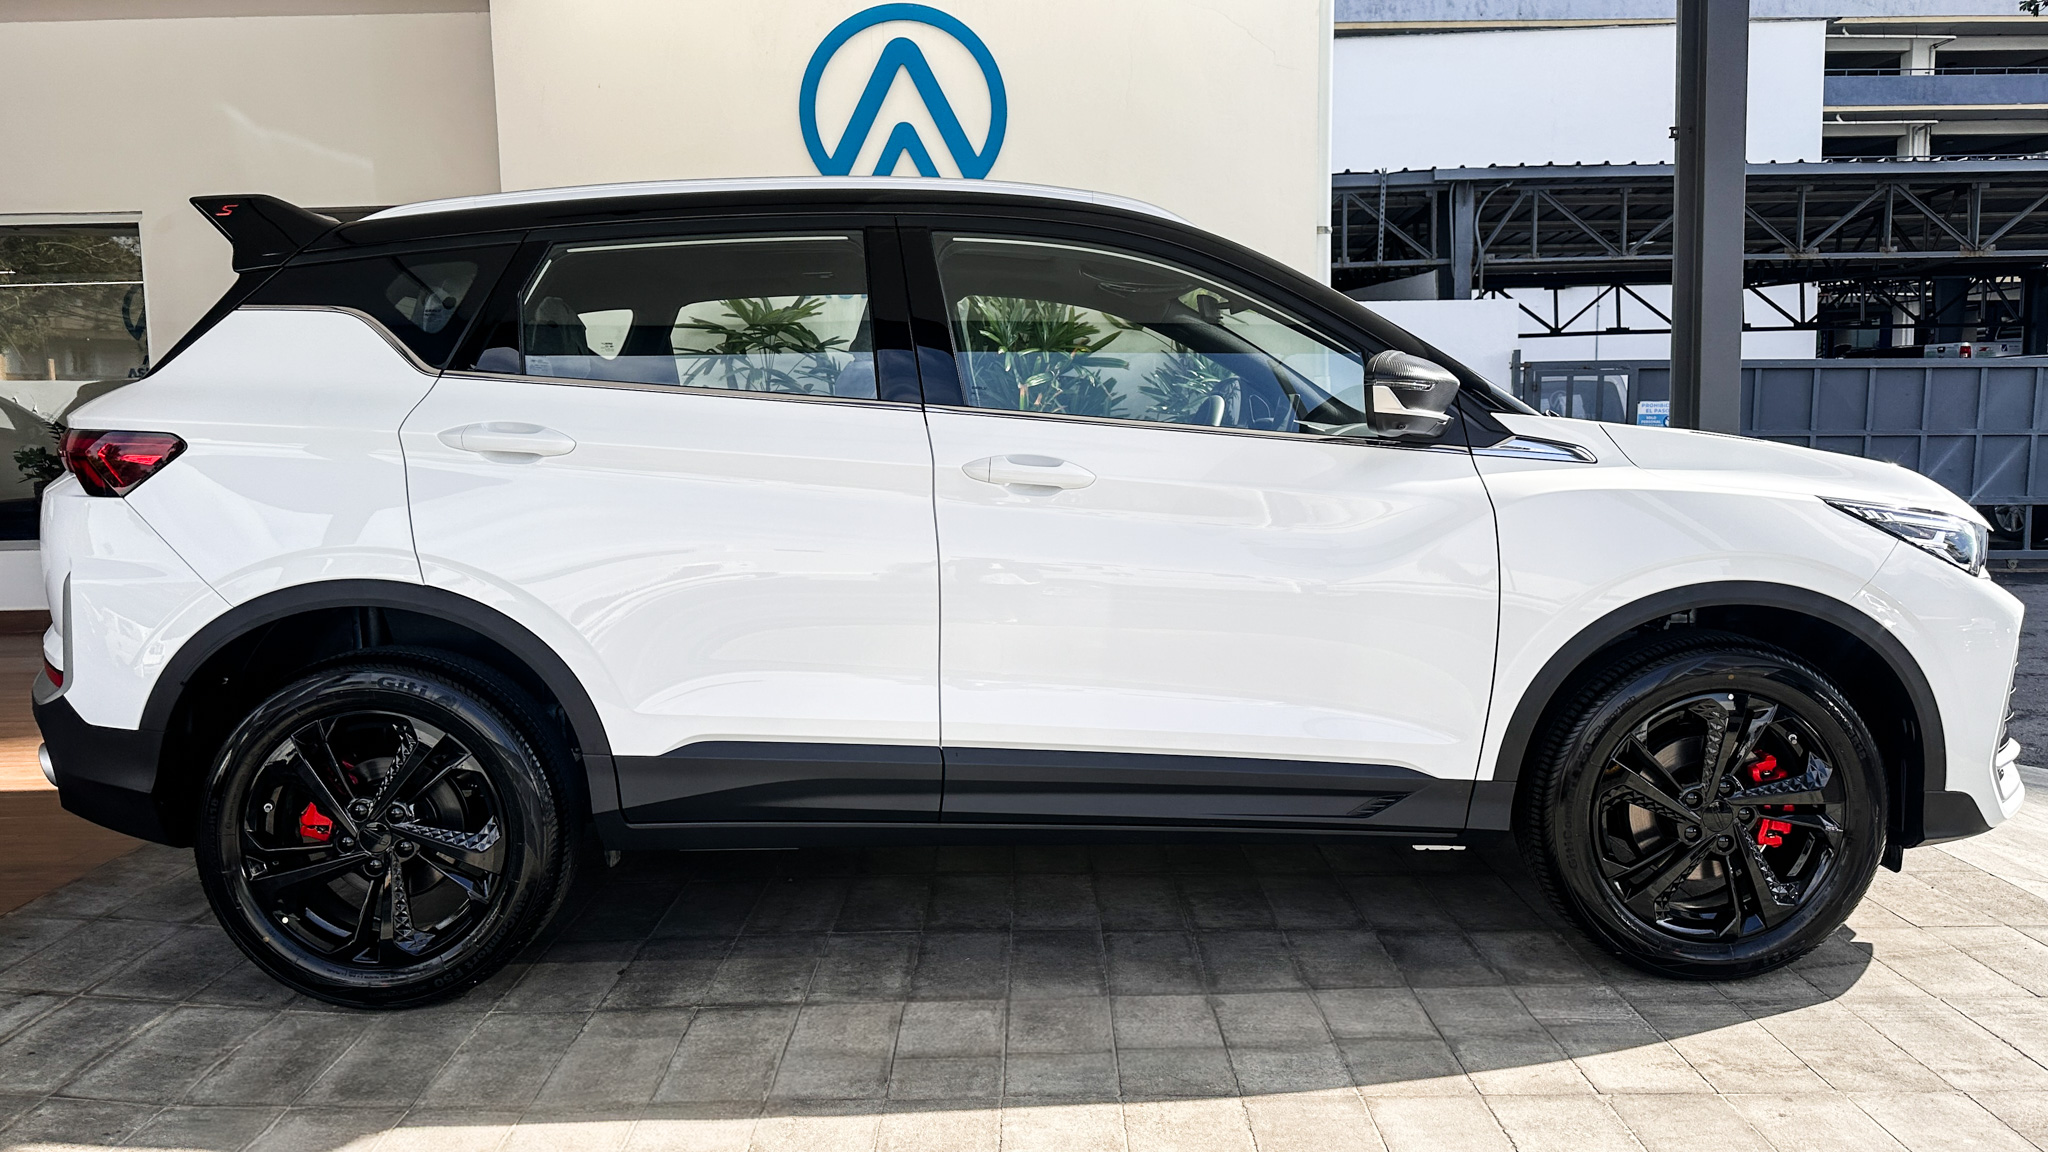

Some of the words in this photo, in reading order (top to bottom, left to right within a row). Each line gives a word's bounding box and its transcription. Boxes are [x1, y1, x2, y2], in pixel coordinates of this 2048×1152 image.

[215, 204, 239, 216] S
[128, 367, 149, 378] AS
[379, 677, 428, 695] Giti
[431, 967, 464, 988] F50
